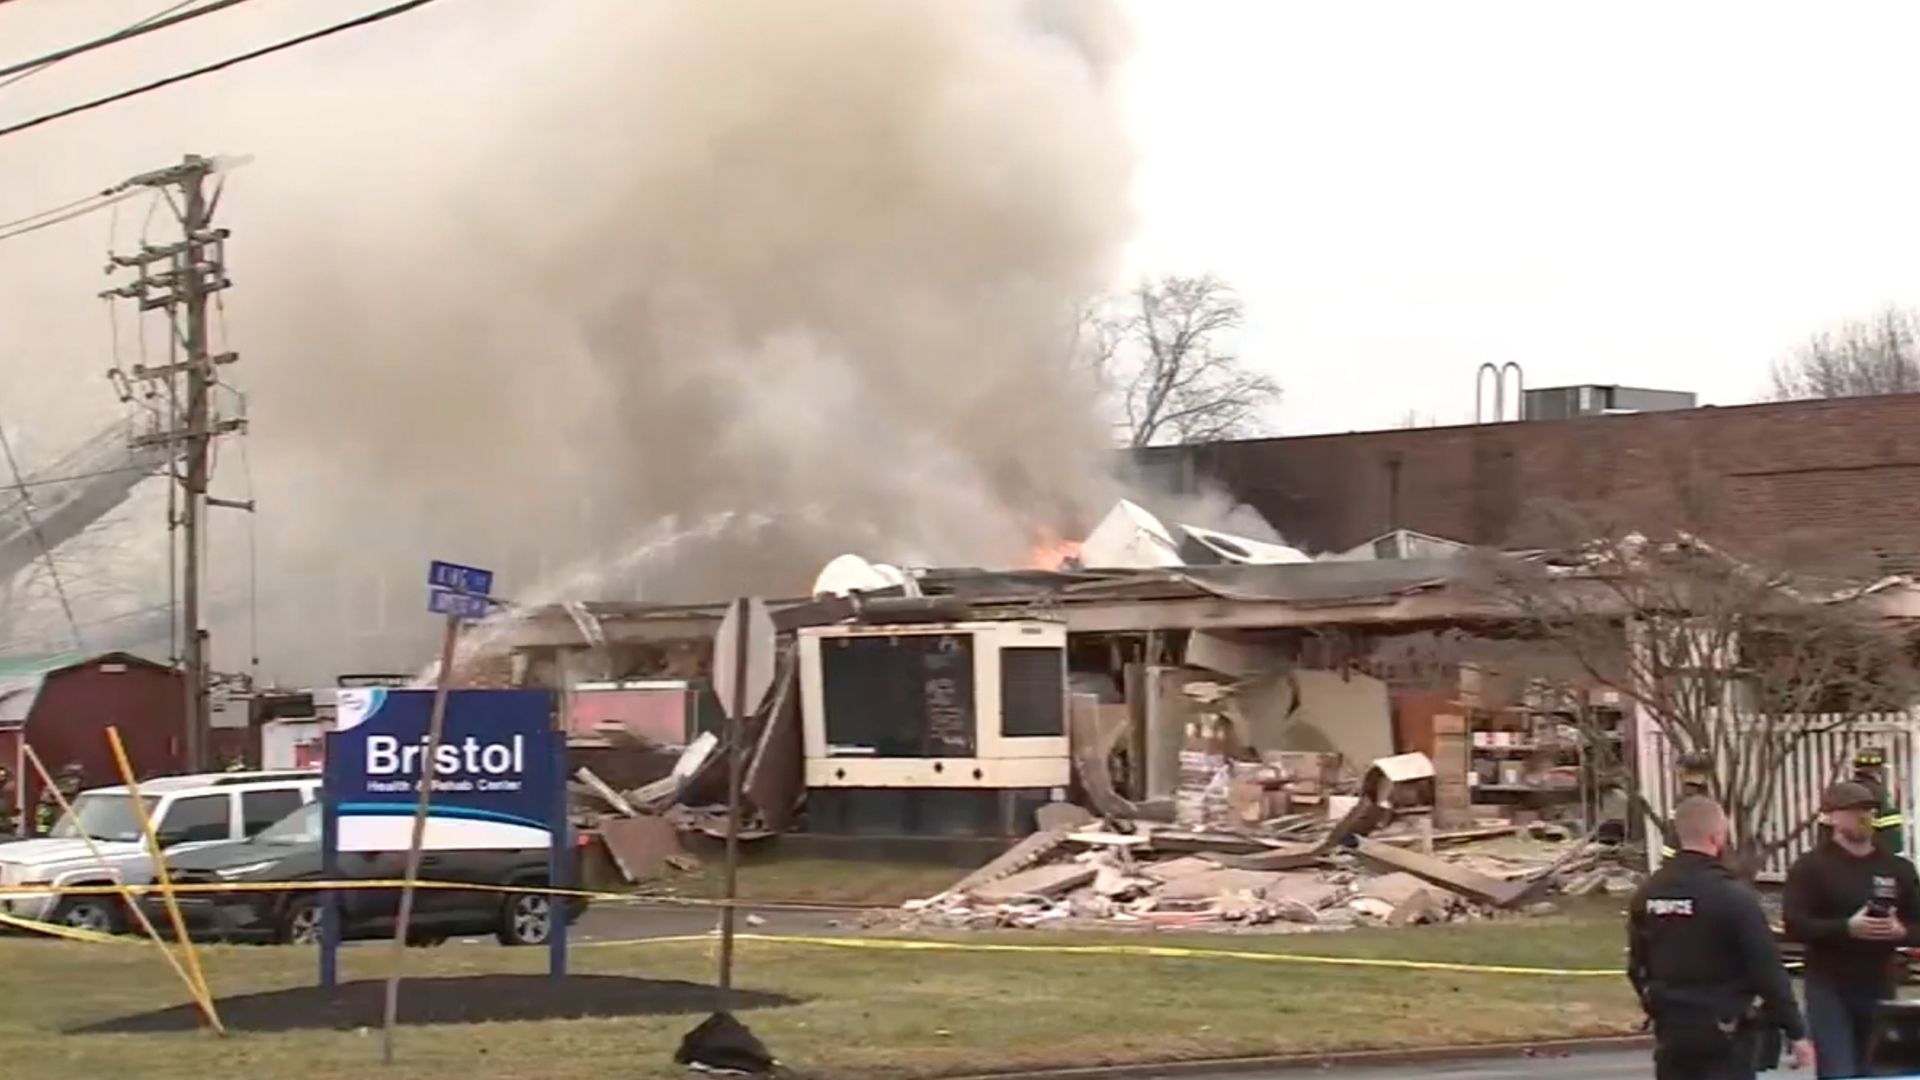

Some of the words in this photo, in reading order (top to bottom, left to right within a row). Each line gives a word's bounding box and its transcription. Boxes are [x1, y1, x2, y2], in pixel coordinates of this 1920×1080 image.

[366, 734, 523, 774] Bristol
[366, 780, 411, 791] Health
[430, 779, 473, 791] Rehab
[477, 779, 522, 791] Center
[1646, 899, 1693, 914] POLICE
